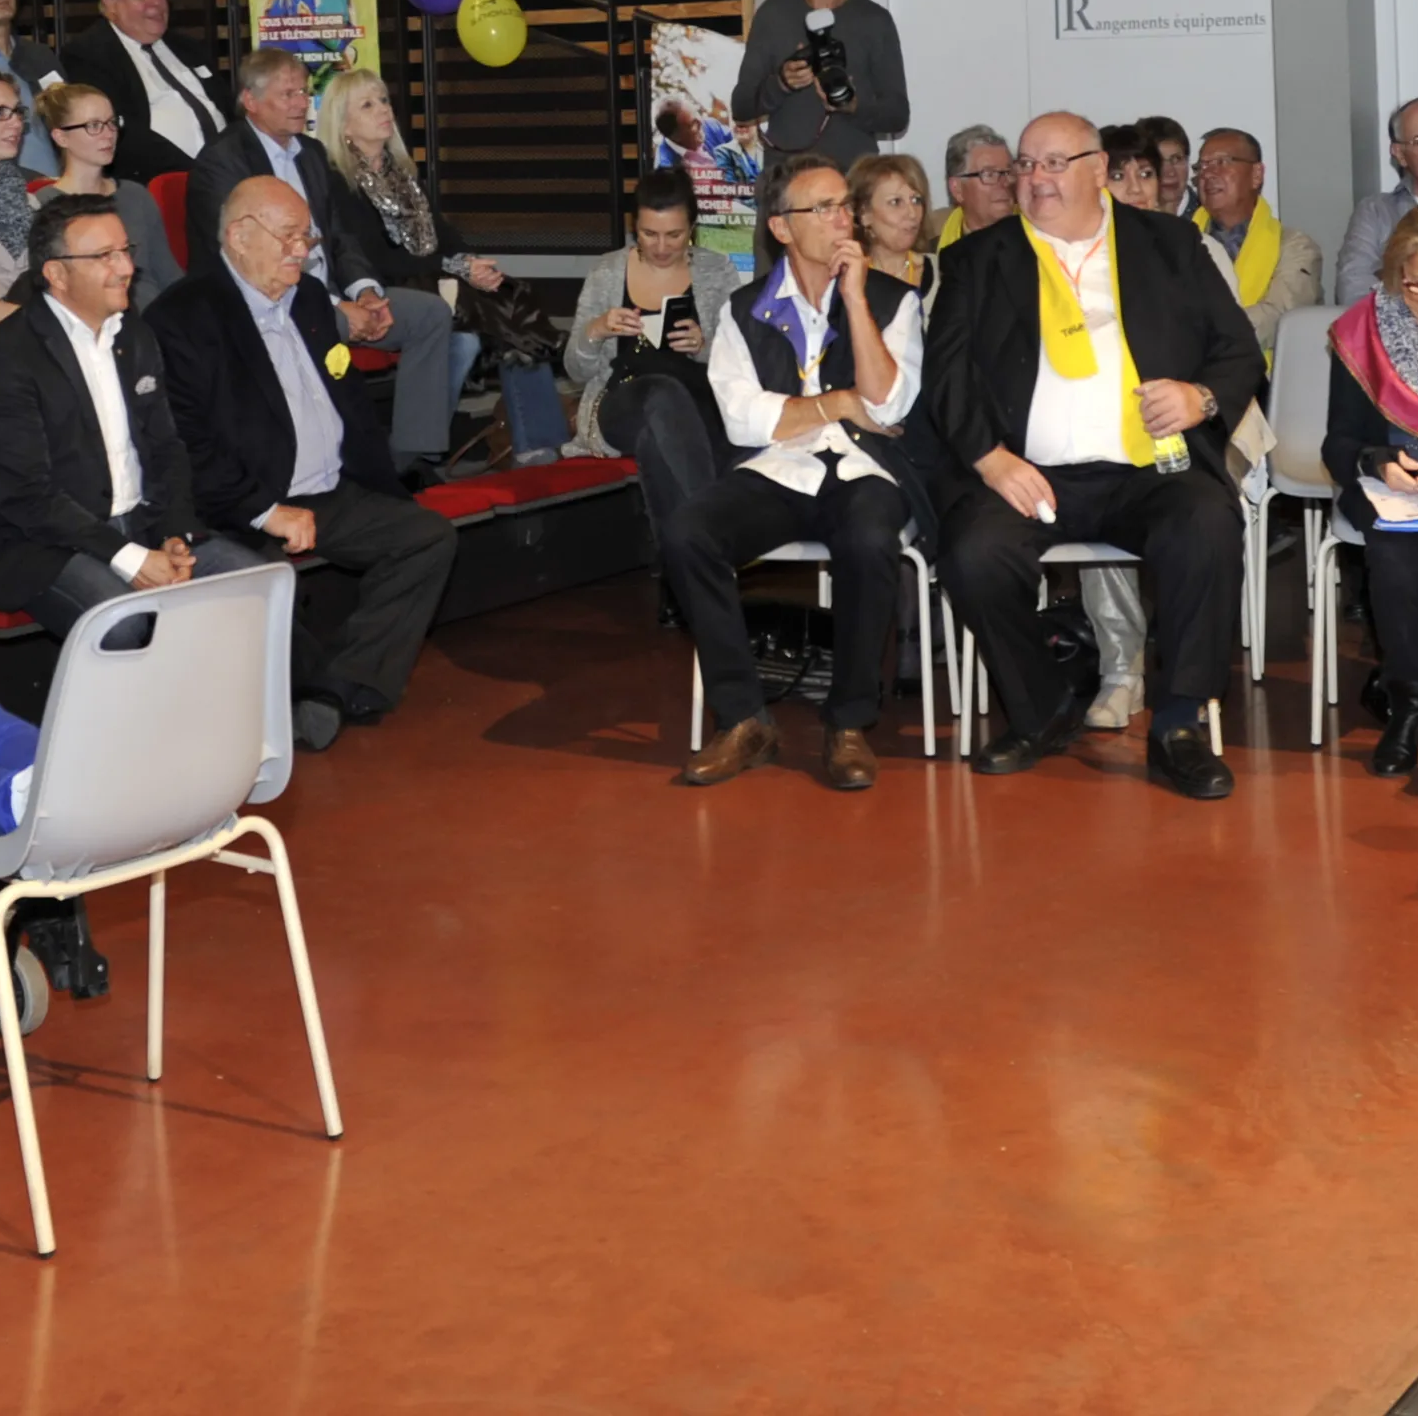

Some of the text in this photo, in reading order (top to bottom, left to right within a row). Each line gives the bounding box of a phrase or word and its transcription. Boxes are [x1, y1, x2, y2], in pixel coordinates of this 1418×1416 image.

[1173, 12, 1266, 32] équipements
[269, 31, 279, 40] LE
[322, 29, 338, 39] EST
[303, 52, 322, 62] MON
[712, 184, 736, 195] MON
[728, 215, 741, 225] LA
